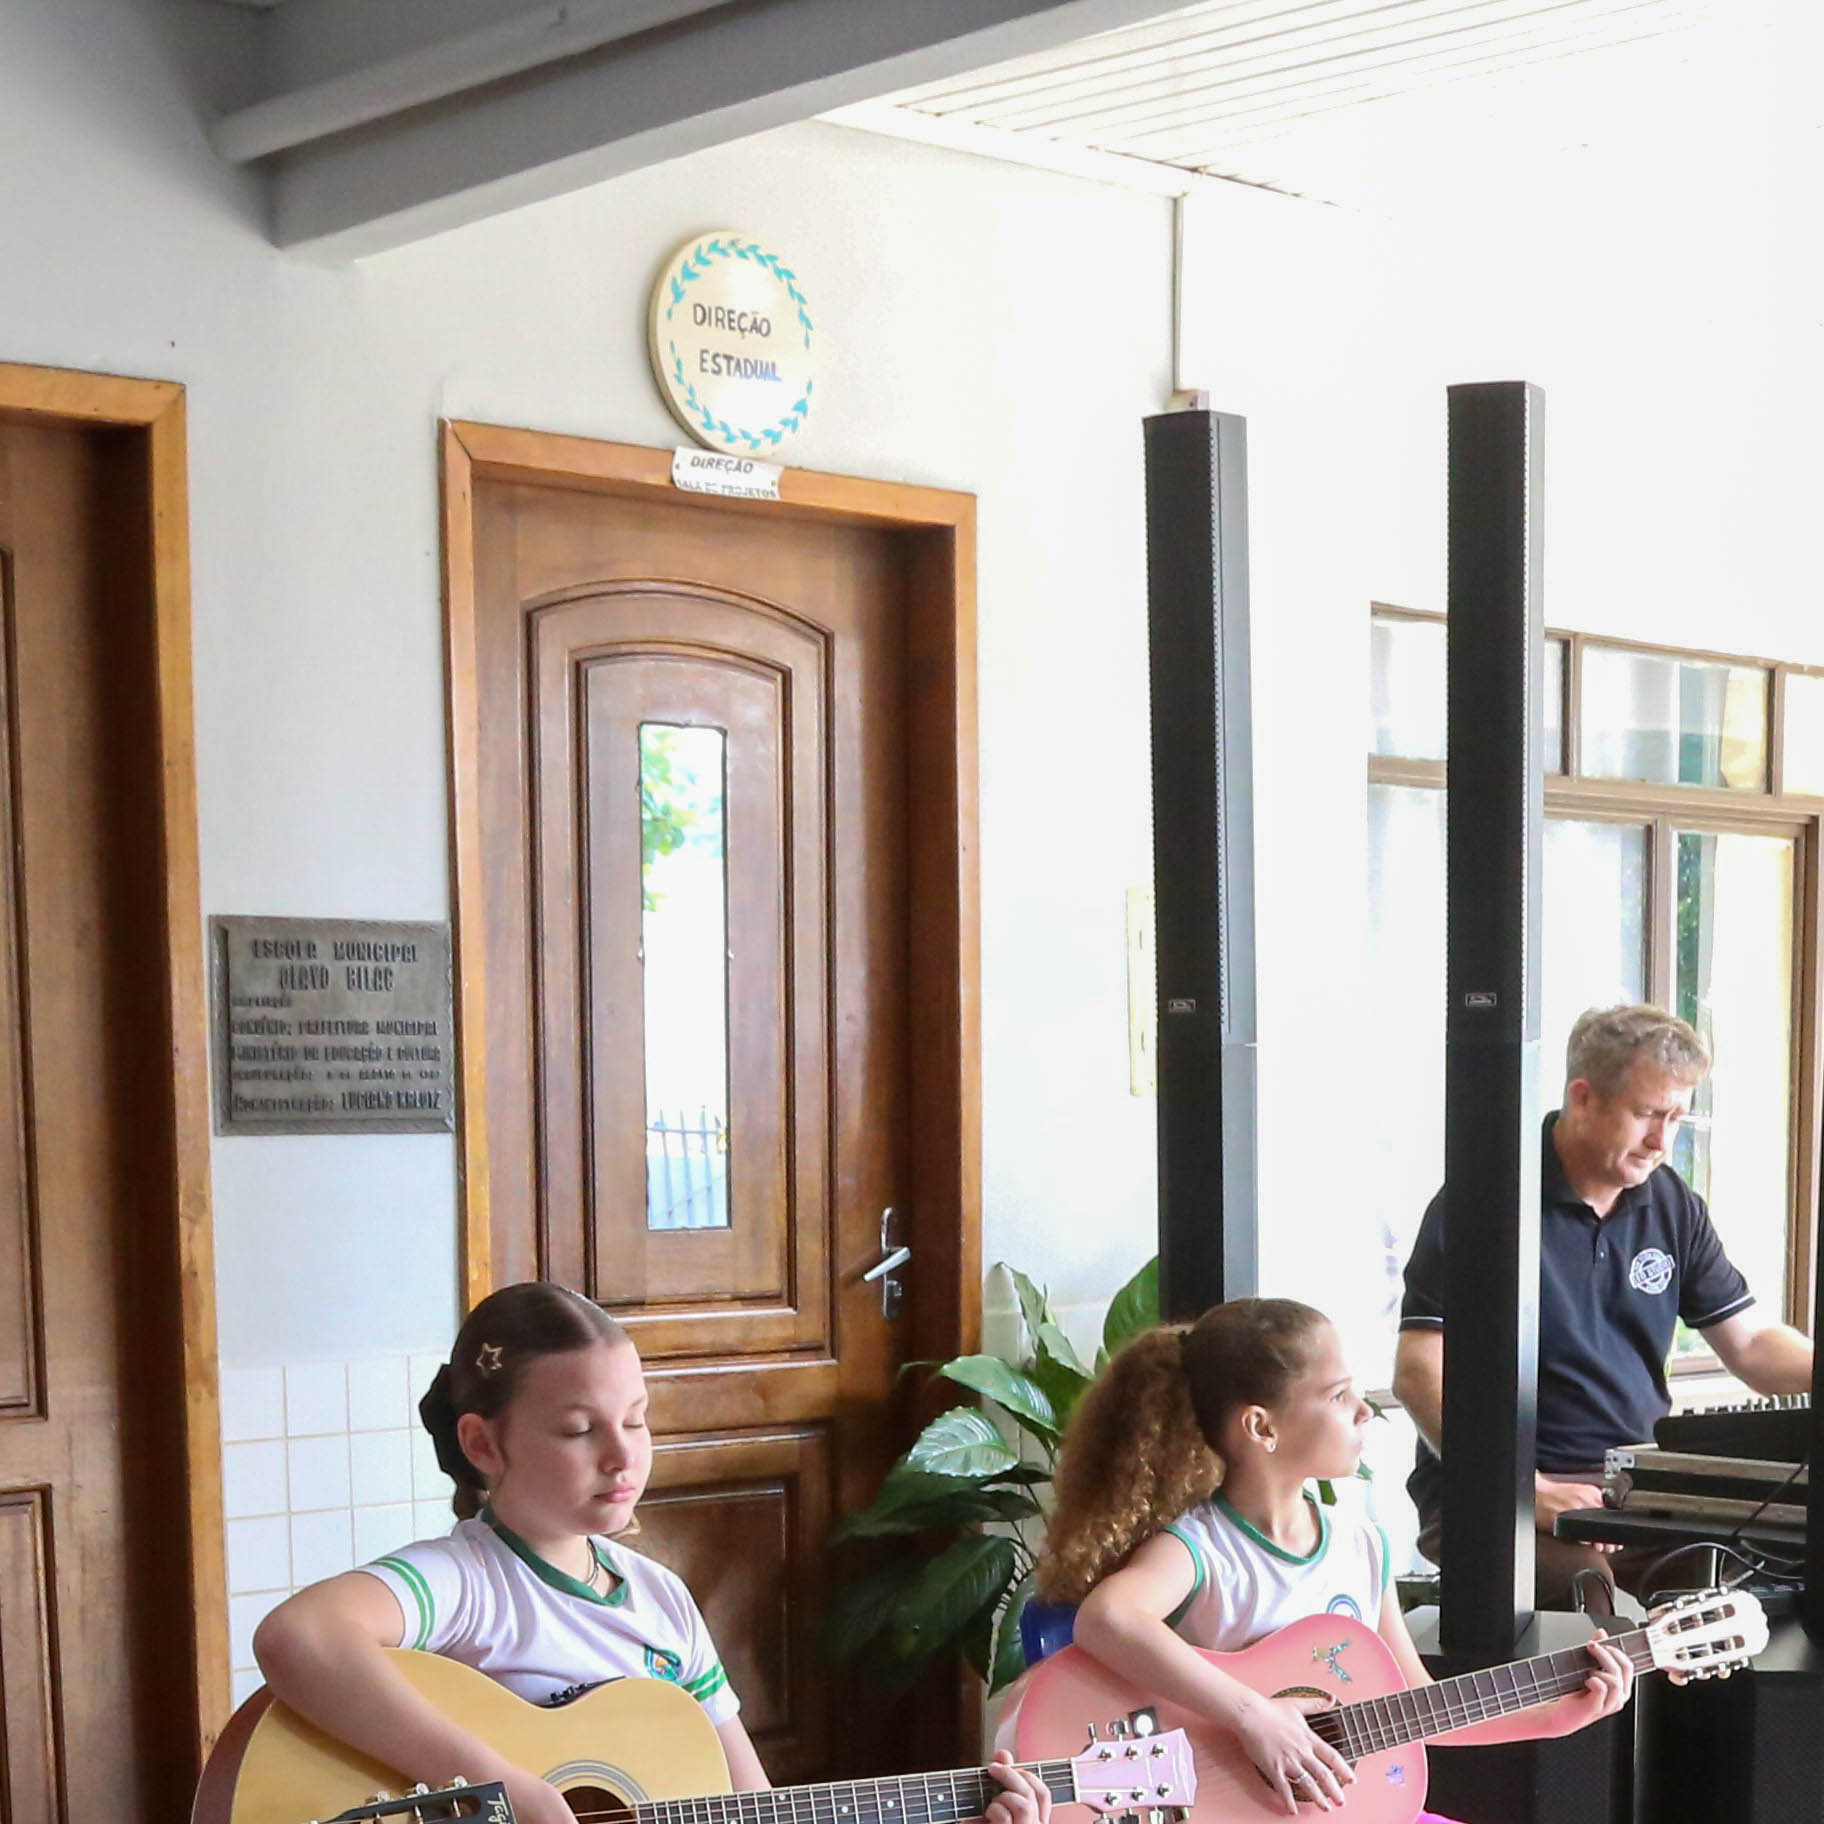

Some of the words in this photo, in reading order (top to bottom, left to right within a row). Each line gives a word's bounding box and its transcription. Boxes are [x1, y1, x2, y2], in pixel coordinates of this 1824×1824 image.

[693, 303, 771, 338] DIREÇÃO
[699, 348, 783, 382] ESTADUAL
[333, 940, 419, 964] MUNICIPAL
